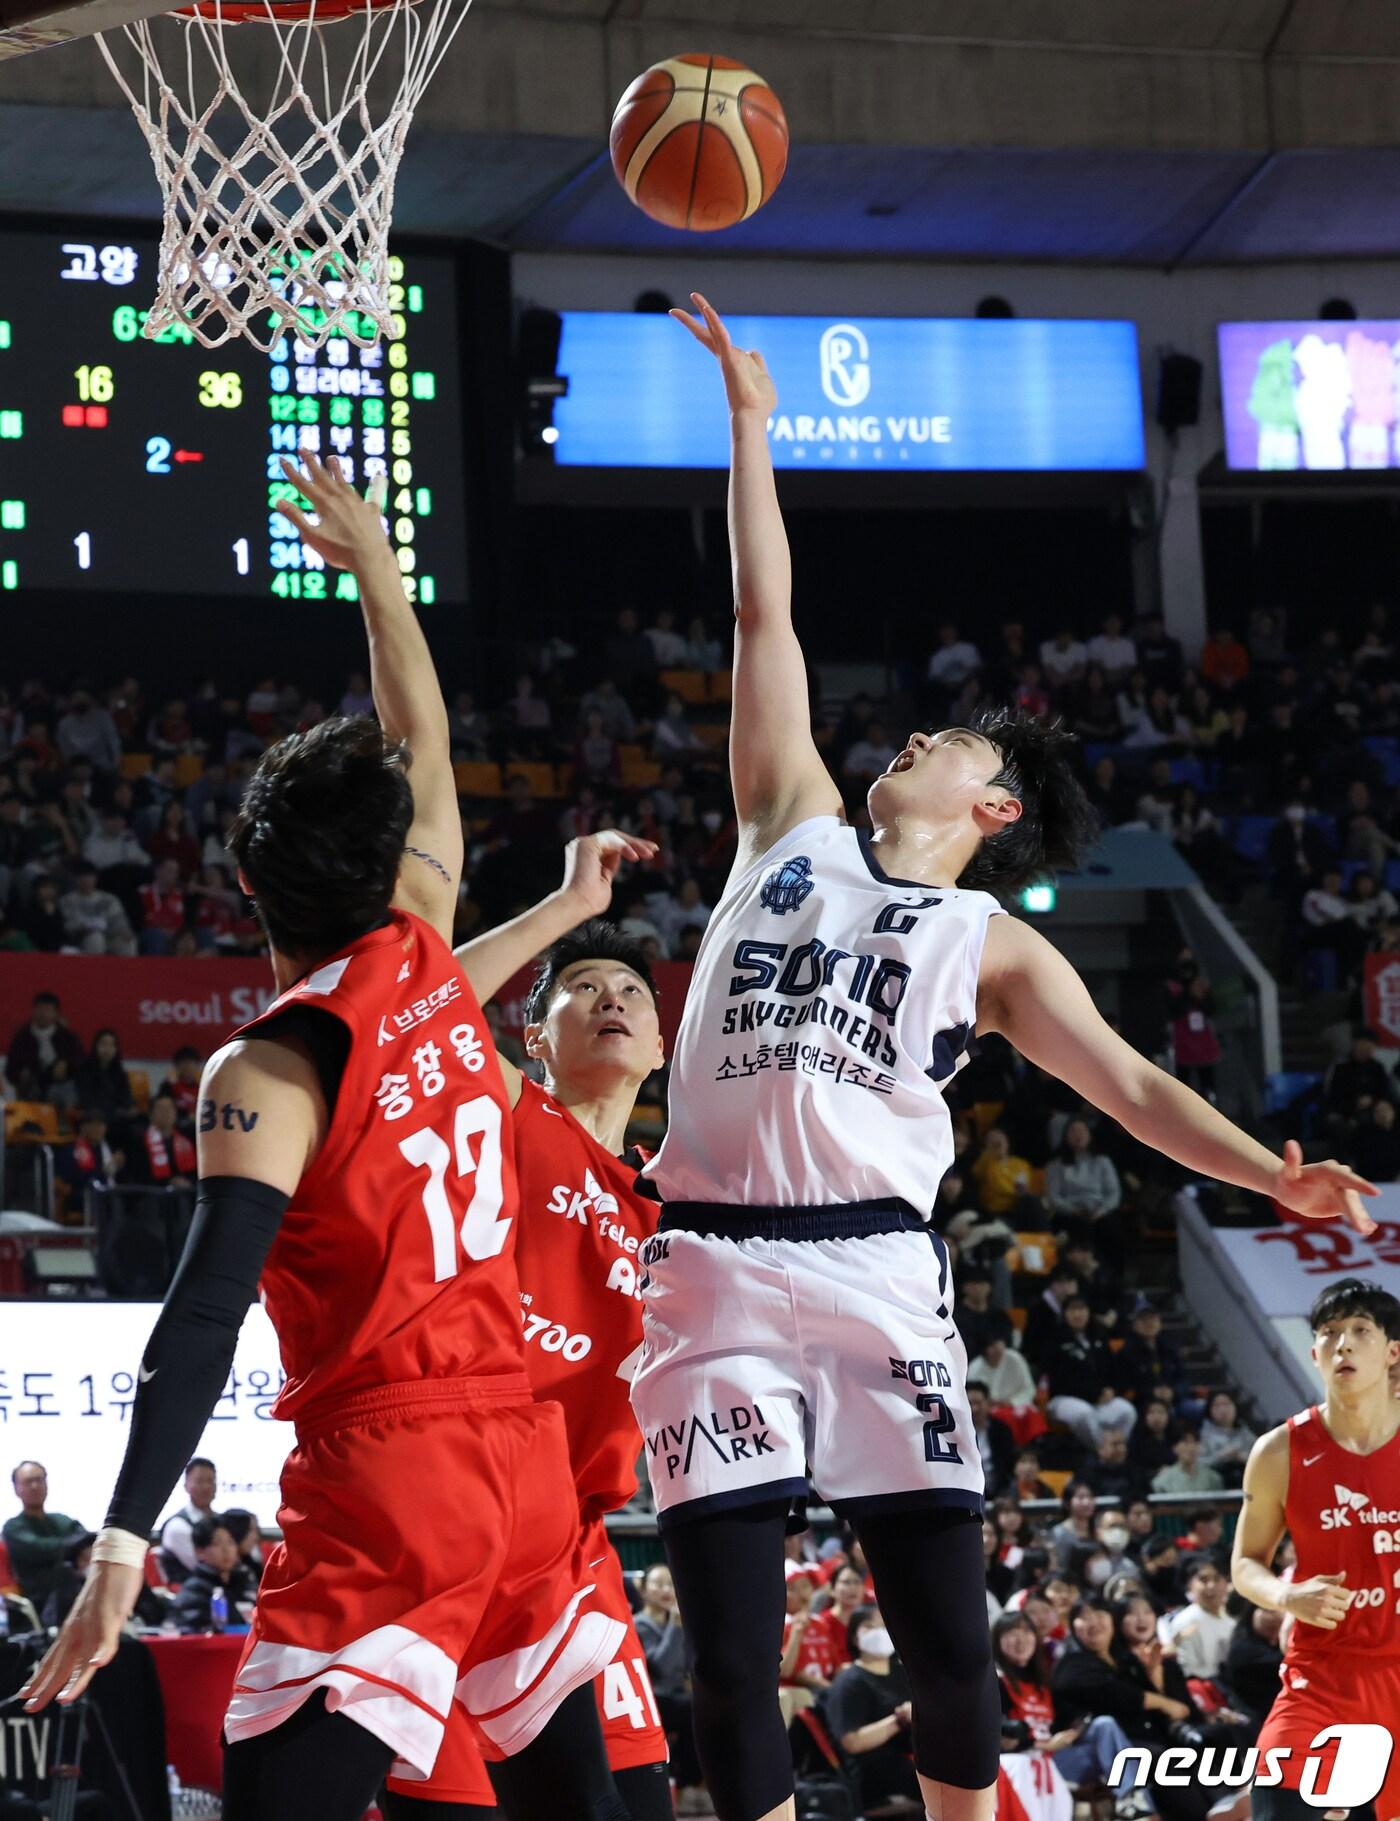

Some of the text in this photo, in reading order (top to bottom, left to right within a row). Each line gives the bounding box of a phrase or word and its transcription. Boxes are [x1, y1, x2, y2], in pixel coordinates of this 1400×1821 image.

[60, 243, 138, 285] 고양
[388, 285, 405, 311] 2
[388, 343, 408, 369] 6
[74, 364, 114, 402] 16
[199, 370, 243, 409] 36
[270, 365, 290, 392] 9
[389, 371, 409, 398] 6
[268, 395, 296, 421] 12
[391, 400, 410, 427] 2
[269, 424, 297, 450] 14
[392, 429, 411, 456] 5
[885, 416, 952, 444] VUE
[145, 436, 171, 473] 2
[392, 458, 413, 486] 0
[394, 488, 413, 514] 4
[395, 517, 415, 544] 0
[74, 530, 91, 570] 1
[232, 538, 249, 575] 1
[269, 541, 301, 570] 34
[397, 546, 416, 573] 0
[270, 571, 301, 599] 41
[872, 896, 944, 935] 2
[138, 993, 222, 1025] seoul
[722, 996, 898, 1068] SKYGUNNERS
[373, 1023, 486, 1121] 송창용
[398, 1094, 513, 1284] 12
[546, 1184, 592, 1226] SK
[647, 1403, 766, 1464] VIVALDI
[916, 1393, 964, 1466] 2
[667, 1424, 776, 1480] PARK
[1320, 1506, 1352, 1530] SK
[602, 1656, 662, 1730] 41
